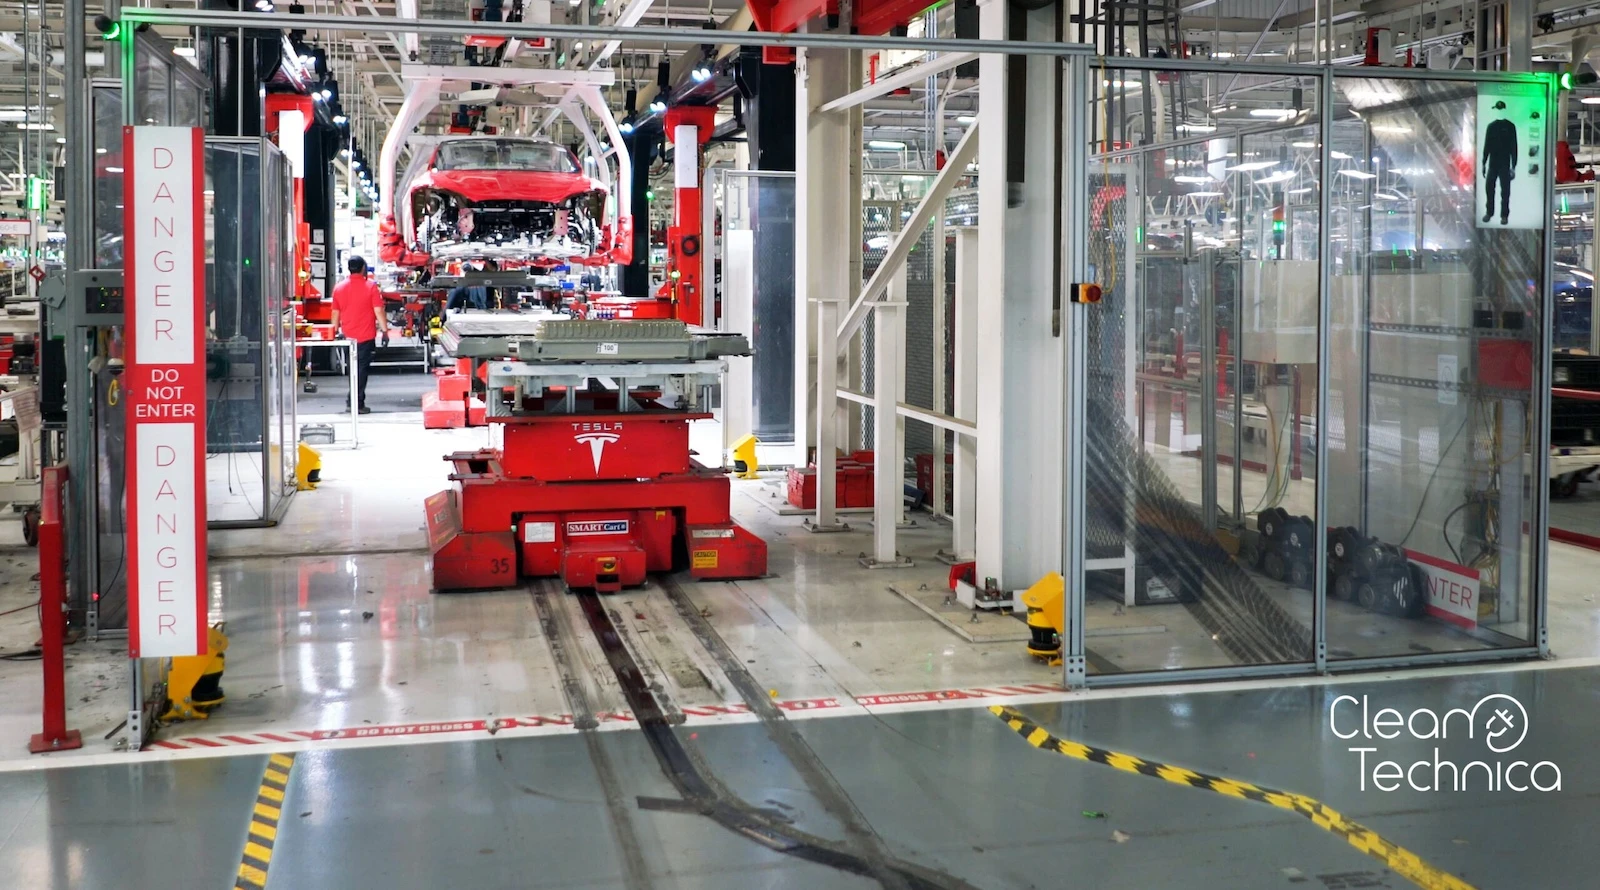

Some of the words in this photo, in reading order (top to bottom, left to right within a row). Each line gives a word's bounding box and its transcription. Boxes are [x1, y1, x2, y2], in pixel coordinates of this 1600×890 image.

[152, 147, 175, 341] DANGER
[151, 368, 180, 383] DO
[146, 386, 185, 400] NOT
[135, 403, 196, 418] ENTER
[571, 422, 623, 431] TESLA
[568, 523, 603, 532] SMART
[155, 445, 177, 635] DANGER
[491, 558, 510, 574] 35
[1426, 574, 1473, 610] NTER
[878, 693, 928, 704] CROSS
[356, 728, 378, 737] DO
[383, 725, 415, 735] NOT
[419, 722, 474, 733] CROSS
